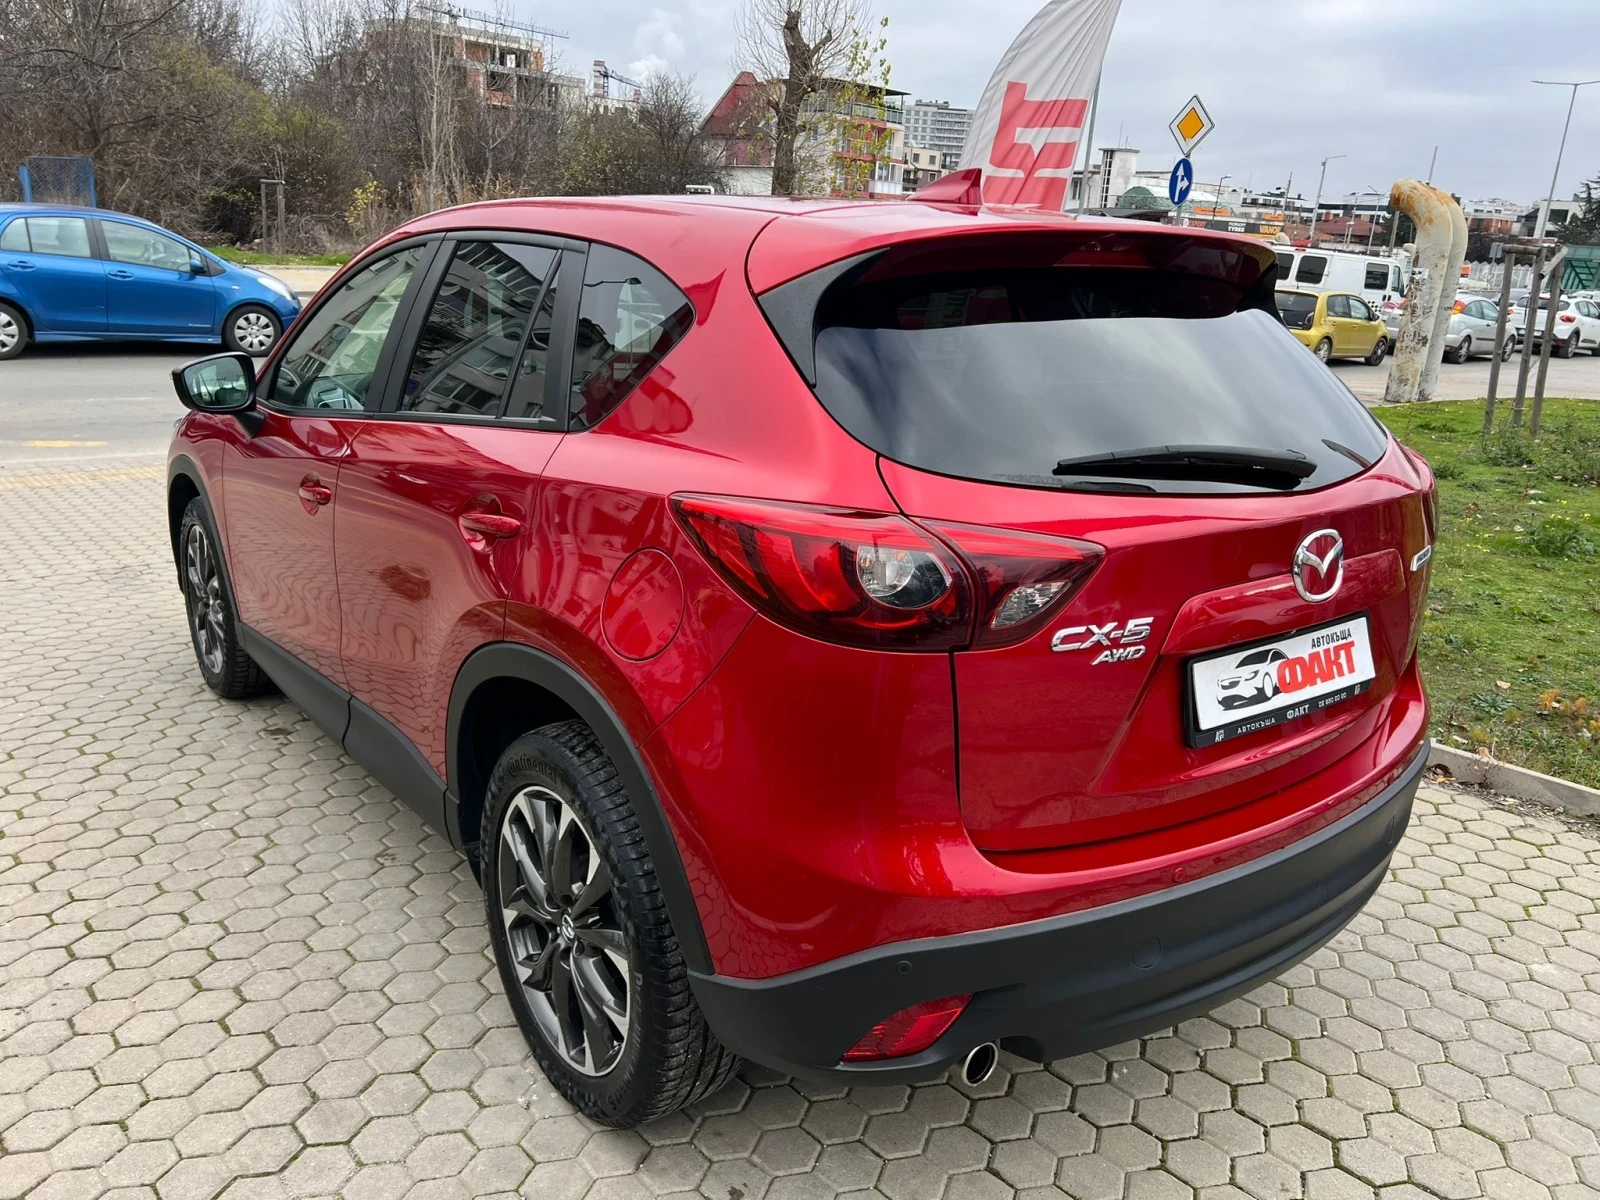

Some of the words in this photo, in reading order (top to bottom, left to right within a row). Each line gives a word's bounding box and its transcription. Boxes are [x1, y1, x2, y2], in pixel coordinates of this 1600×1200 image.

[1051, 617, 1154, 652] CX-5
[1311, 628, 1352, 650] АВТОКЪЩА
[1090, 645, 1146, 666] AWD
[1277, 640, 1356, 694] ФАКТ
[1286, 704, 1310, 719] ФАКТ
